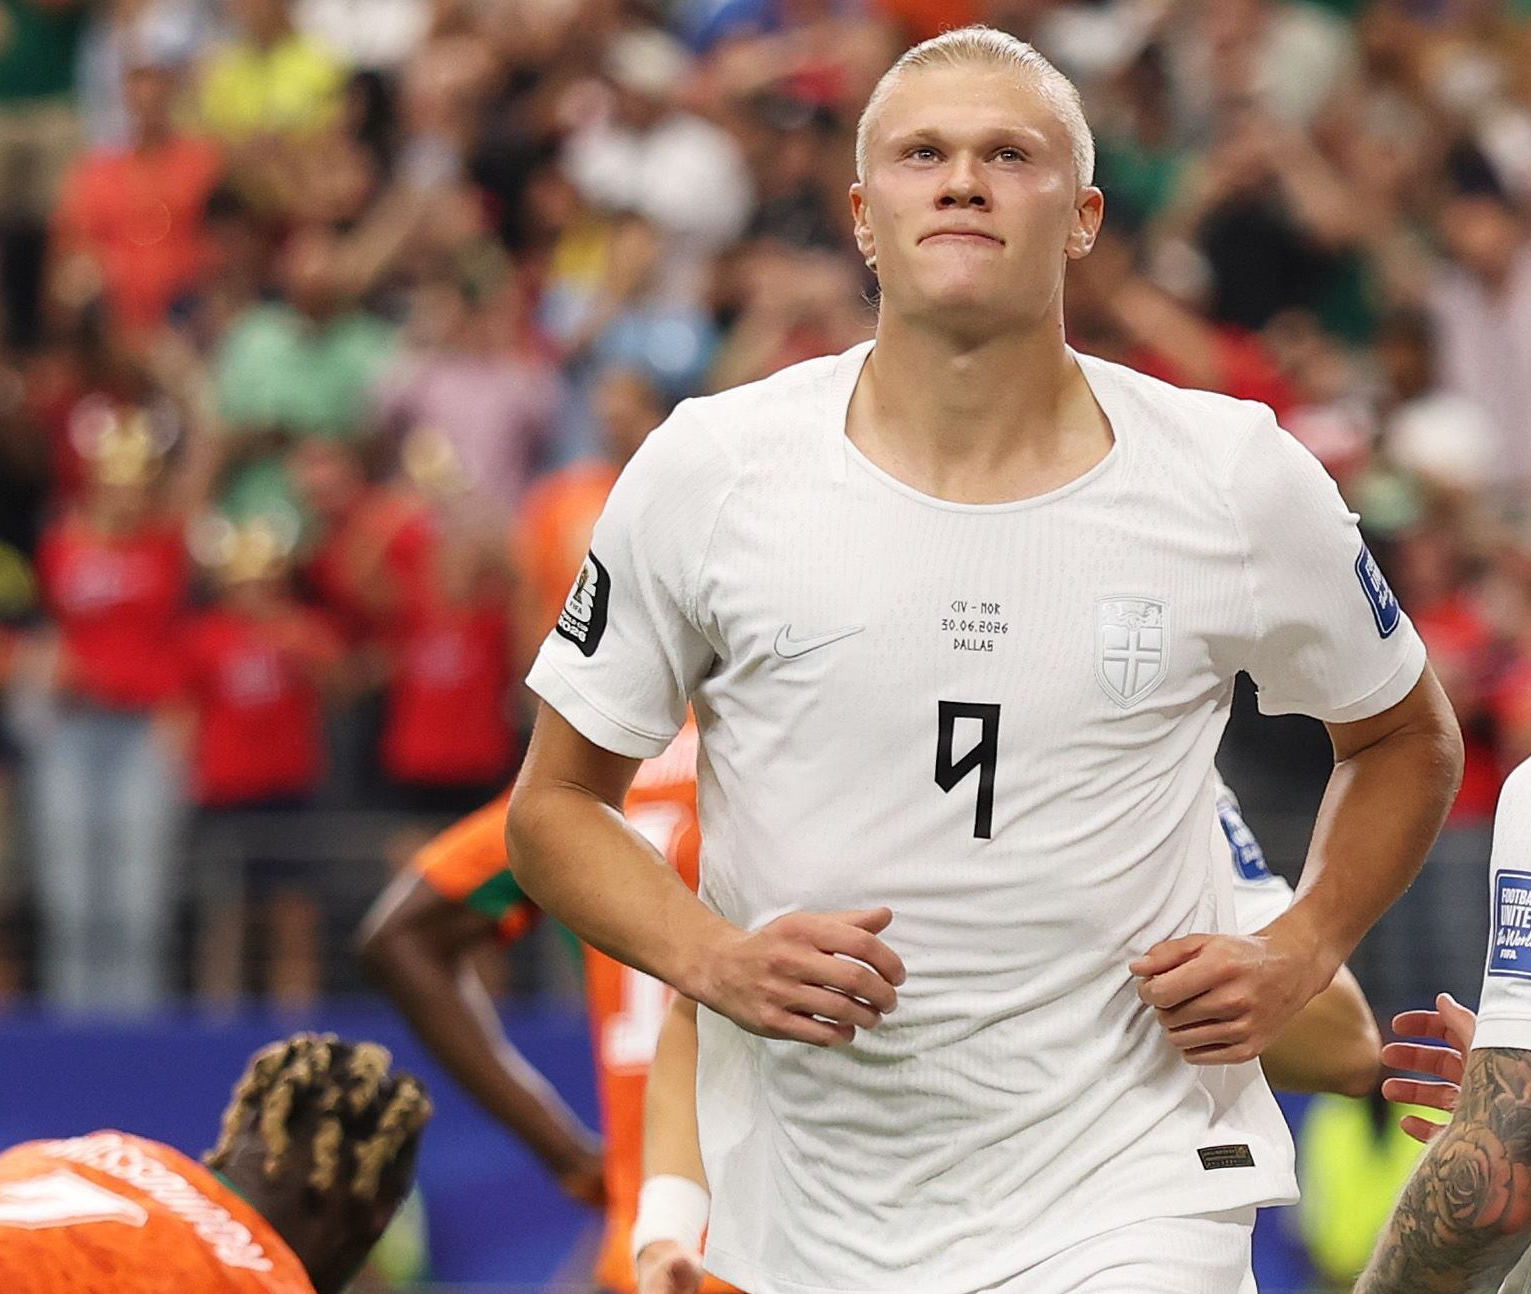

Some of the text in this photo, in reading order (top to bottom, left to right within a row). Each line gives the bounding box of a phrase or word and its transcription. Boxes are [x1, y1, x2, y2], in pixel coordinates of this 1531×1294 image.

[951, 600, 968, 613] CIV
[980, 602, 1001, 615] NOR
[941, 618, 1009, 634] 30.06.2026
[953, 638, 994, 652] DALLAS
[935, 700, 1001, 839] 9
